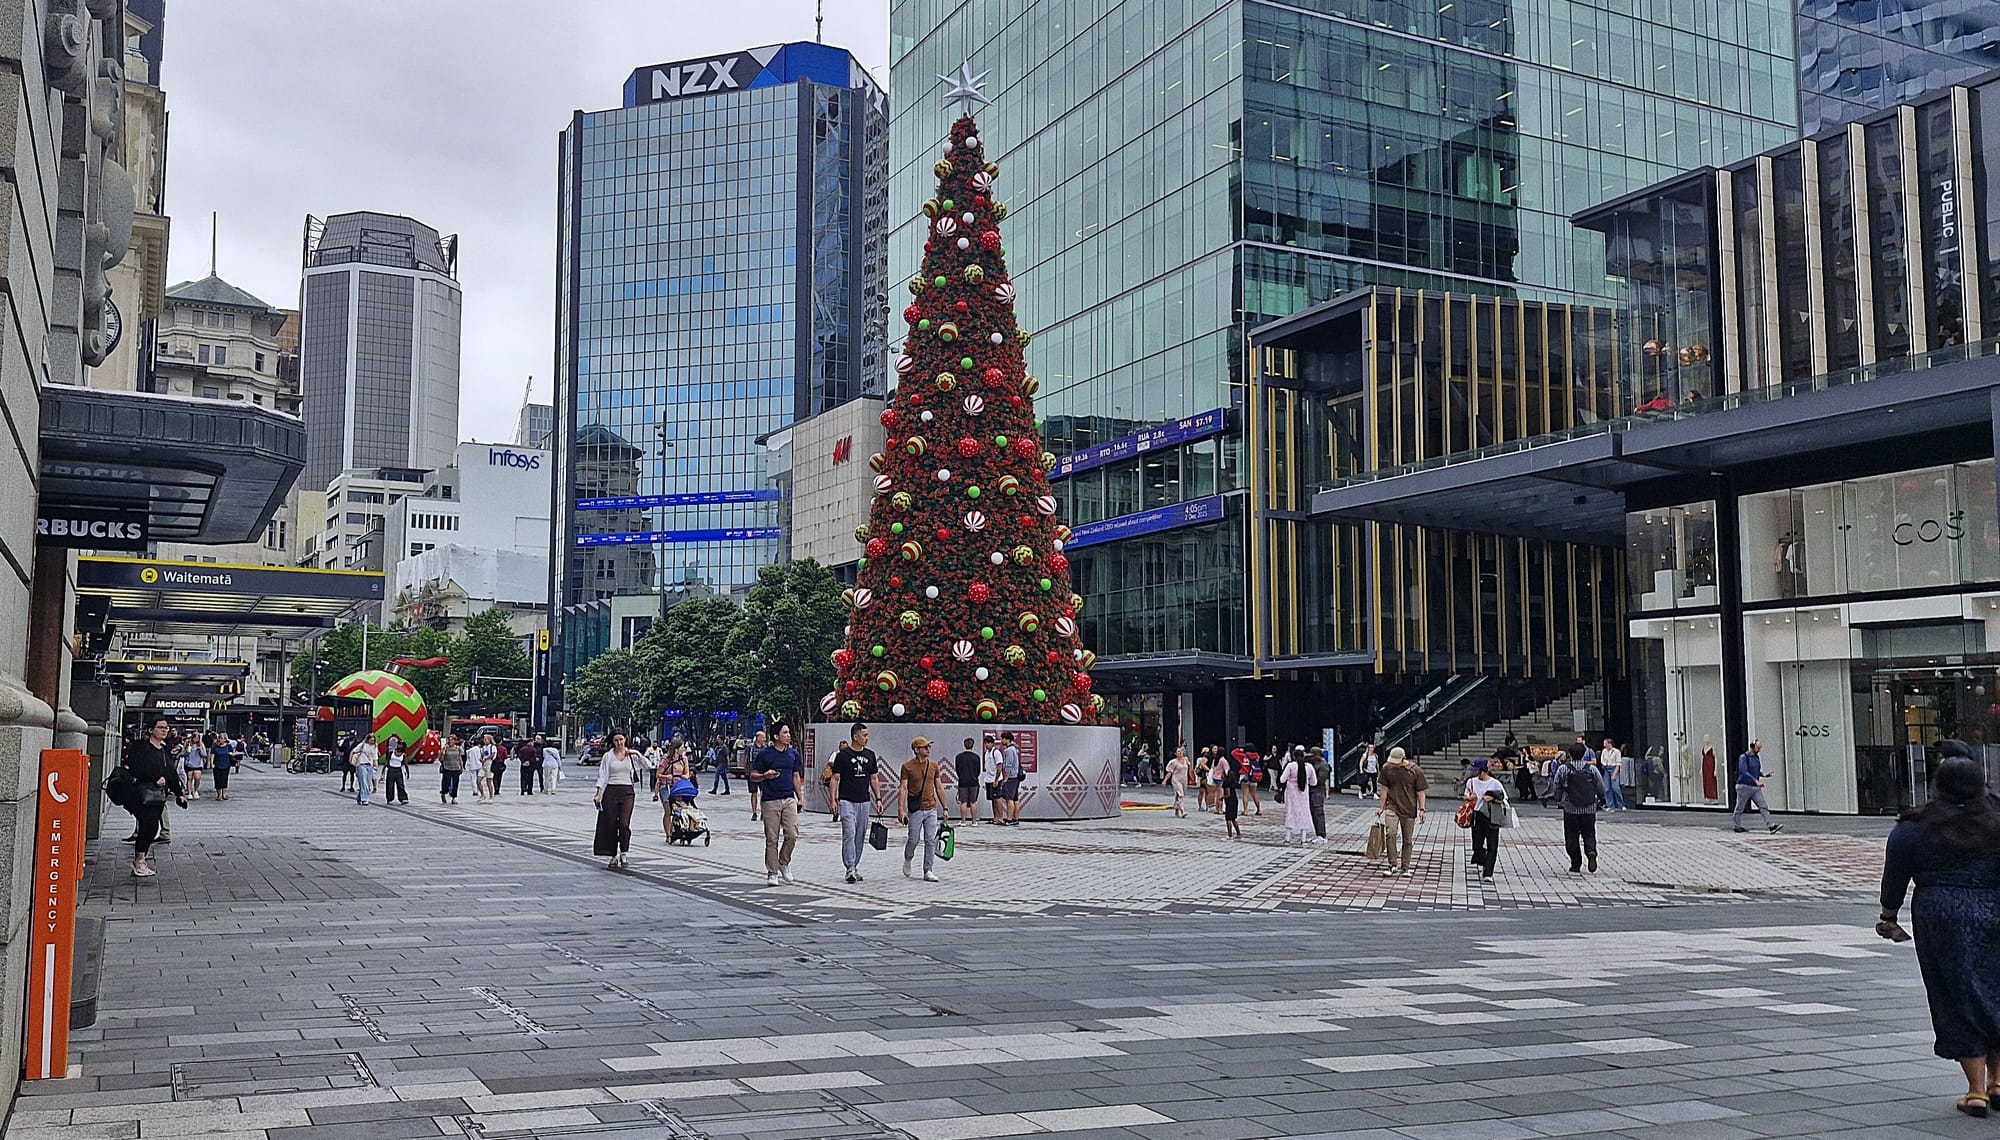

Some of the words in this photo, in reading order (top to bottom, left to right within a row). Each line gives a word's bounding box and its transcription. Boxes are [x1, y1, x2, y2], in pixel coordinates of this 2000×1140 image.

[652, 57, 739, 99] NZX
[1941, 179, 1955, 238] PUBLIC
[1179, 419, 1192, 430] SAN
[1137, 433, 1150, 442] RUA
[489, 448, 540, 471] Infosys
[1892, 516, 1966, 546] COS
[163, 570, 232, 585] Waitematā
[156, 700, 211, 709] McDonald's
[1798, 724, 1831, 738] COS
[47, 819, 61, 933] EMERGENCY
